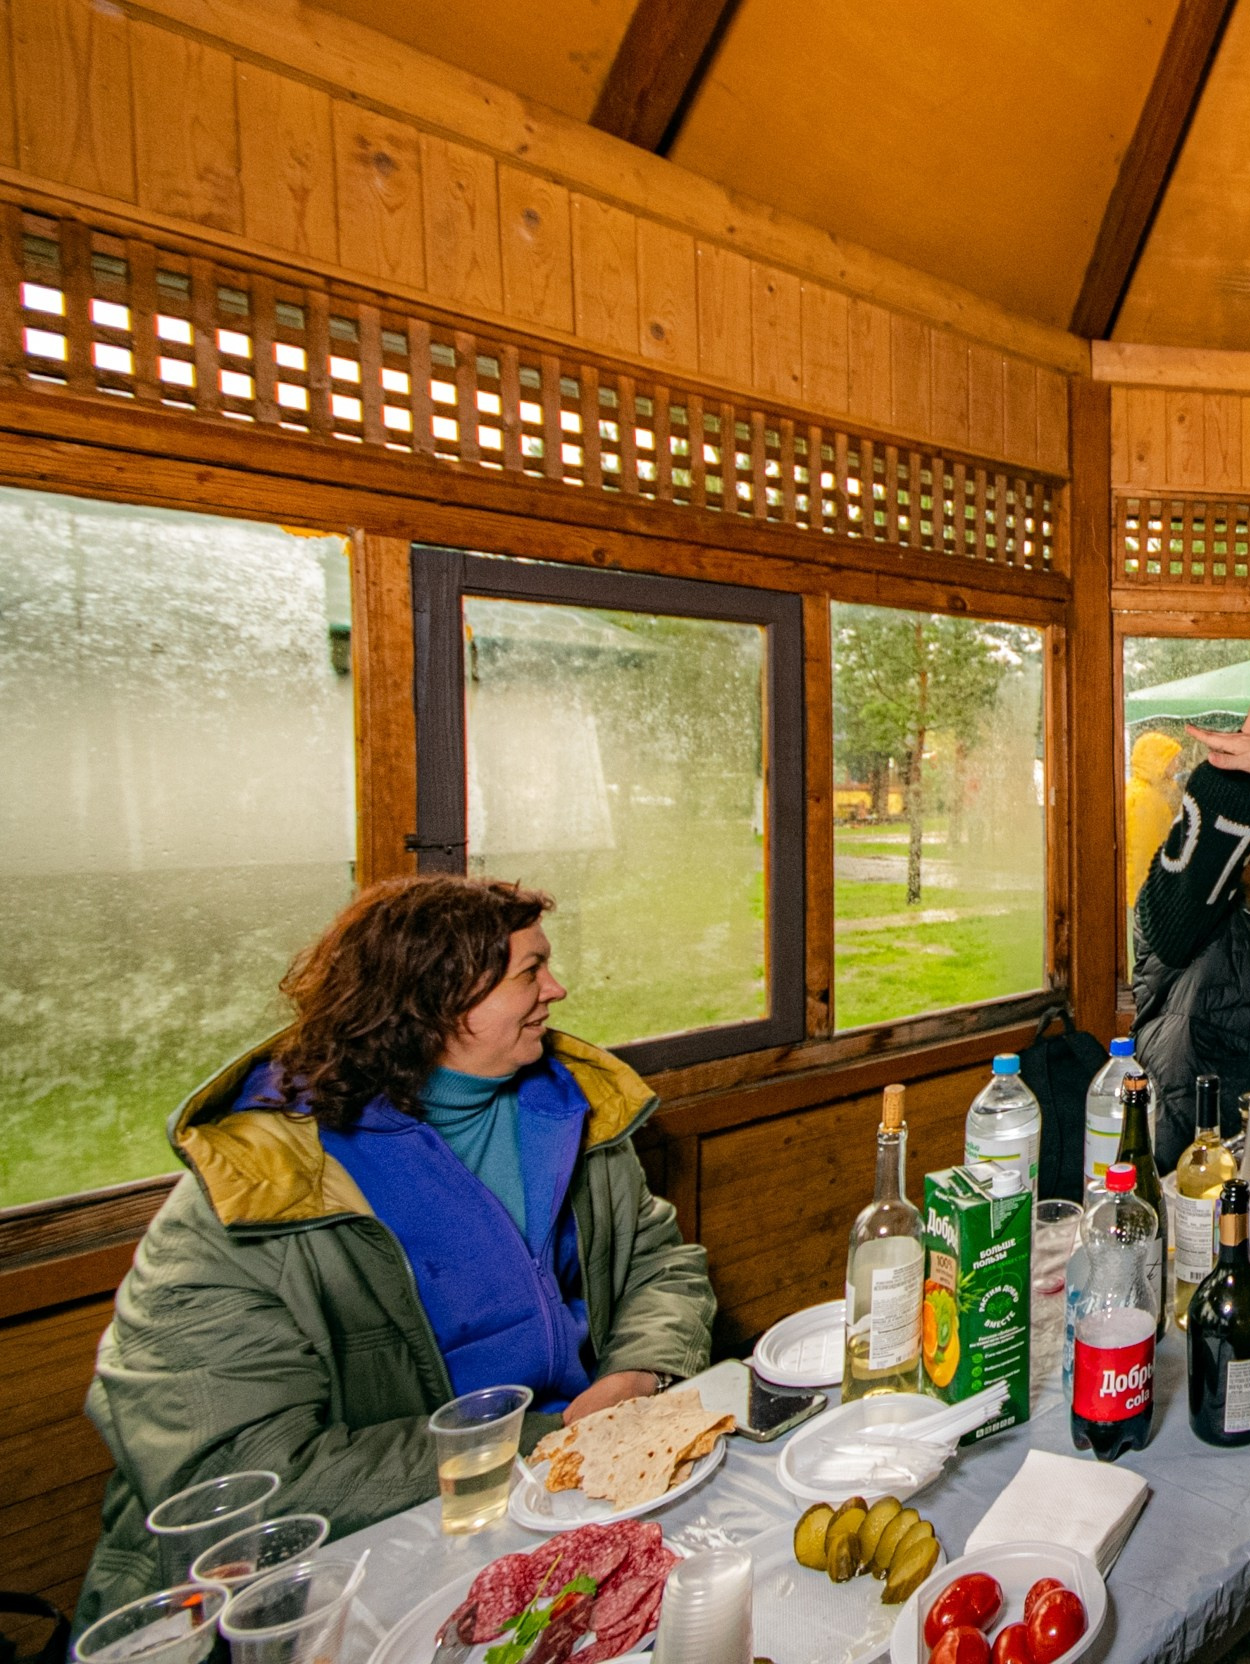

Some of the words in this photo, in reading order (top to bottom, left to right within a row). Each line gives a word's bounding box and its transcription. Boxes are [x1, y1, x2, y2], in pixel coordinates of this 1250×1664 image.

[979, 1237, 1017, 1260] БОЛЬШЕ
[972, 1250, 1008, 1271] ПОЛЬЗЫ
[978, 1284, 1002, 1313] РАСТИМ
[1002, 1284, 1019, 1303] ДОБРО
[983, 1310, 1016, 1329] ВМЕСТЕ
[1125, 1389, 1150, 1410] cola
